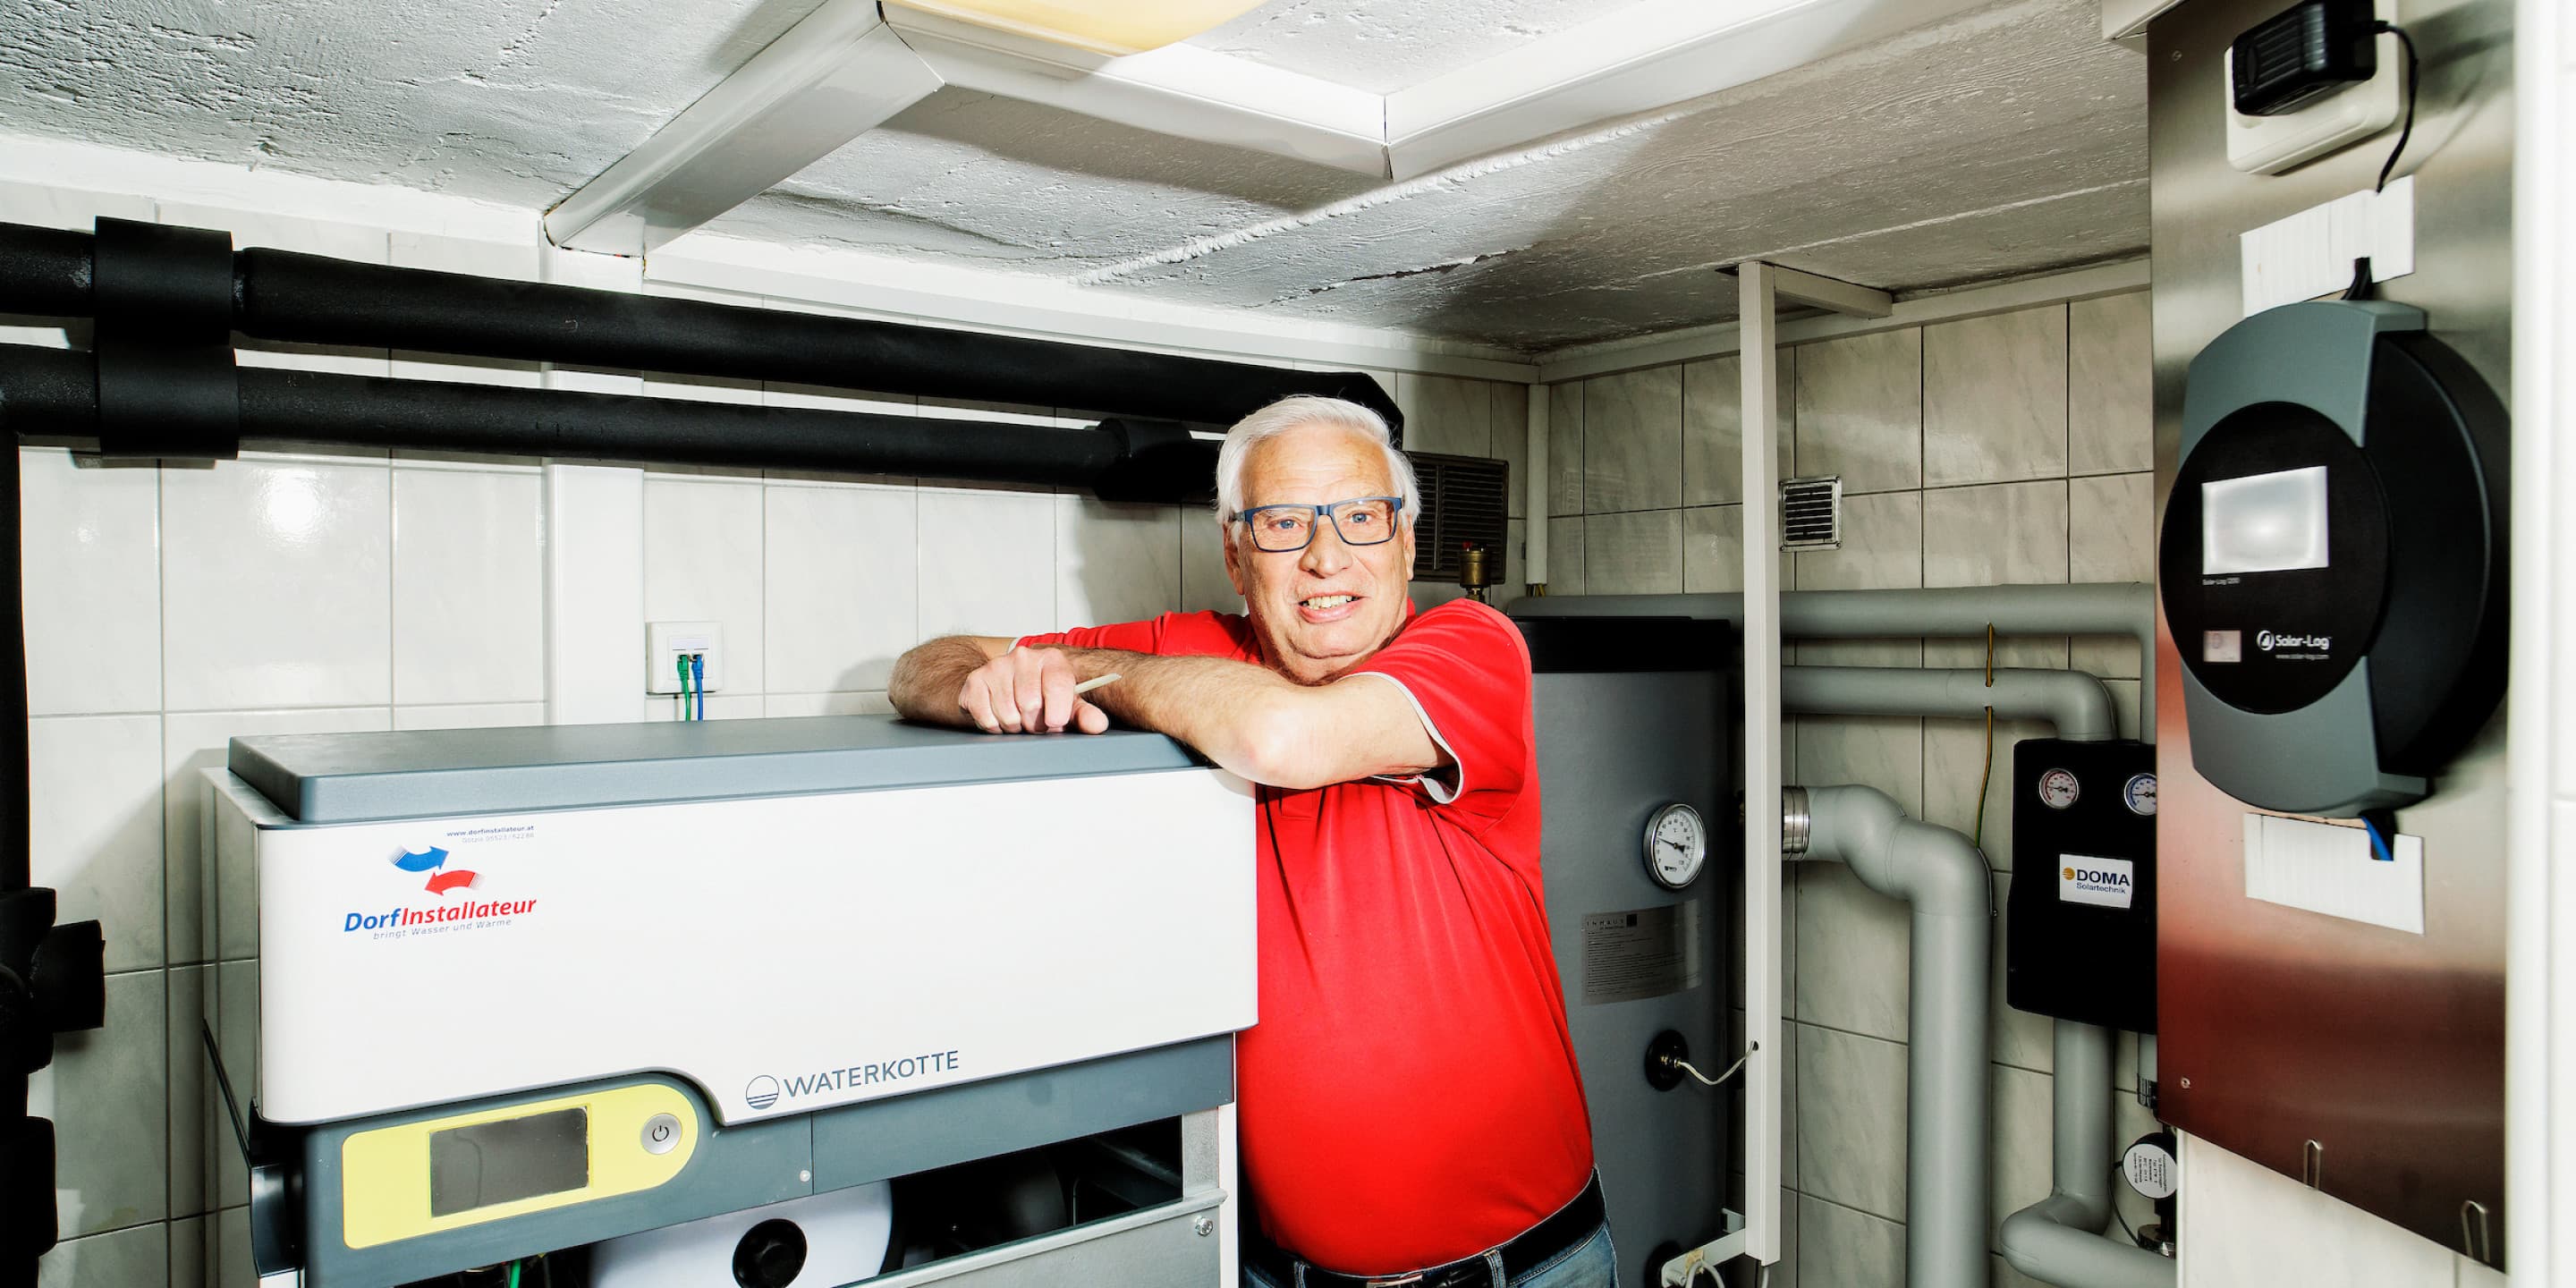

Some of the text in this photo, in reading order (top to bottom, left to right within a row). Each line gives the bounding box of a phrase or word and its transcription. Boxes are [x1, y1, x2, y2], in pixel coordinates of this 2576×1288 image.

[2275, 634, 2330, 650] Solar-Log
[446, 826, 535, 837] www.dorfinstallateur.at
[2077, 869, 2131, 886] DOMA
[2076, 882, 2126, 894] Solartechnik
[373, 919, 513, 940] bringt Wasser und Wärme
[784, 1050, 959, 1097] WATERKOTTE
